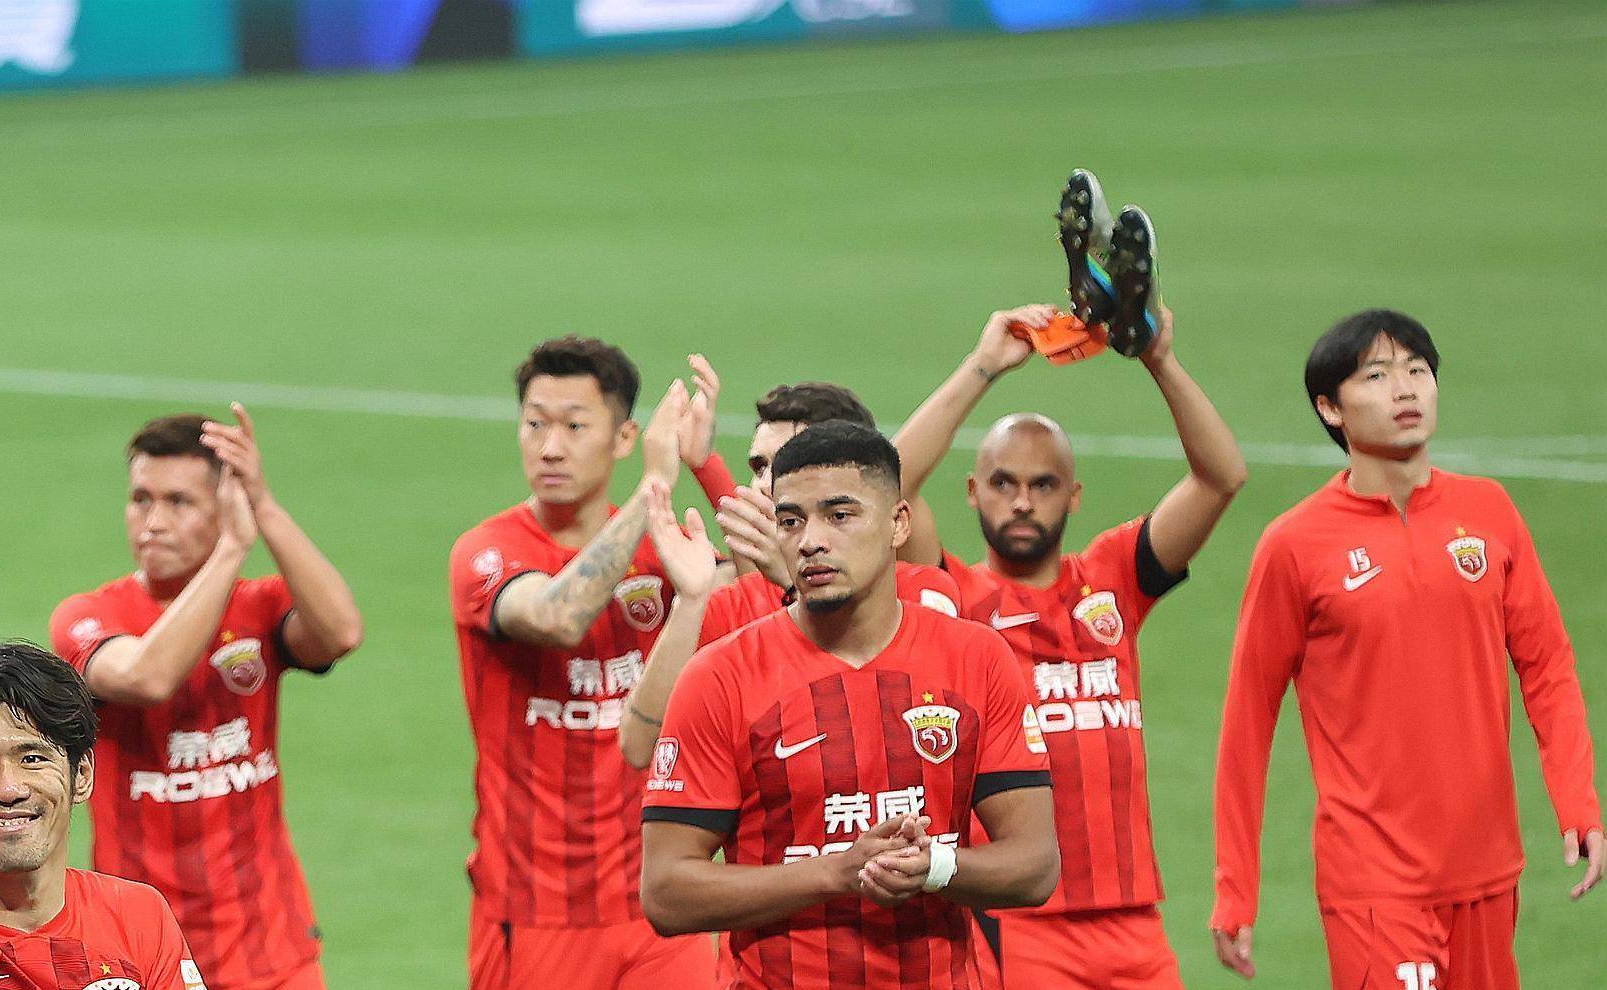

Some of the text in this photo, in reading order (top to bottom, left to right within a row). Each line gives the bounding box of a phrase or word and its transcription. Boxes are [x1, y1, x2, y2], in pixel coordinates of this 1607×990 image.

[1347, 547, 1371, 573] 15
[1034, 657, 1120, 700] 荣威
[526, 697, 620, 729] ROE
[1035, 699, 1142, 734] OEW
[130, 749, 278, 803] ROEWE
